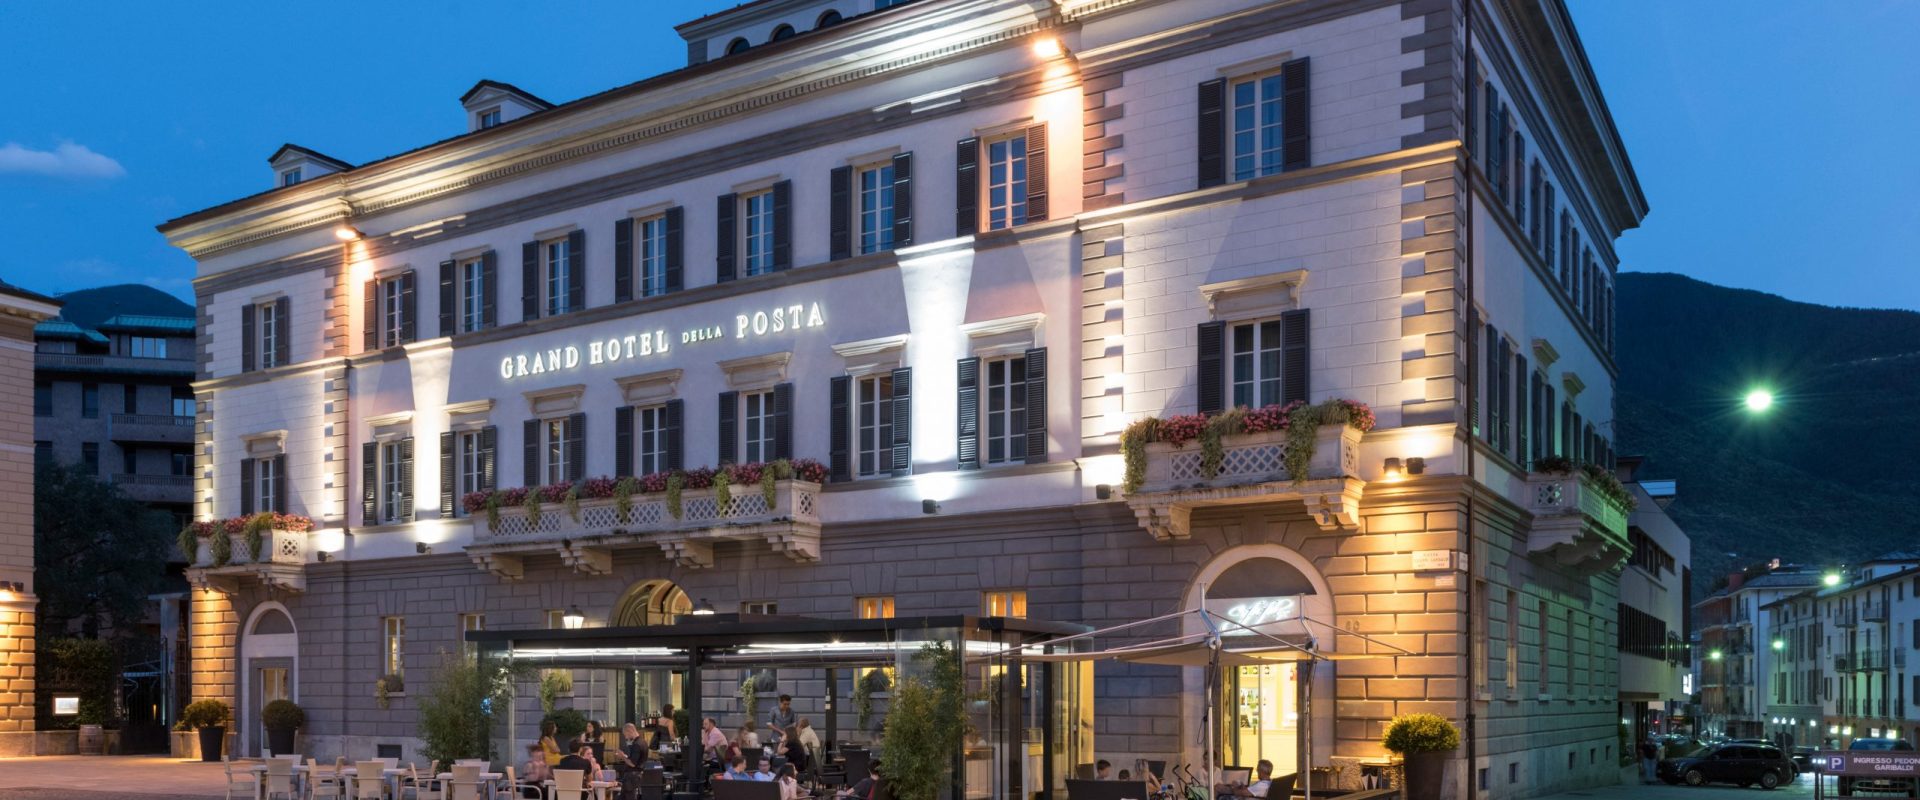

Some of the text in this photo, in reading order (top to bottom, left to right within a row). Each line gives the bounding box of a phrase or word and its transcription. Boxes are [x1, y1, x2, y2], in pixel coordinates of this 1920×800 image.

[501, 301, 824, 379] GRAND HOTEL DELLA POSTA
[1831, 758, 1842, 769] P
